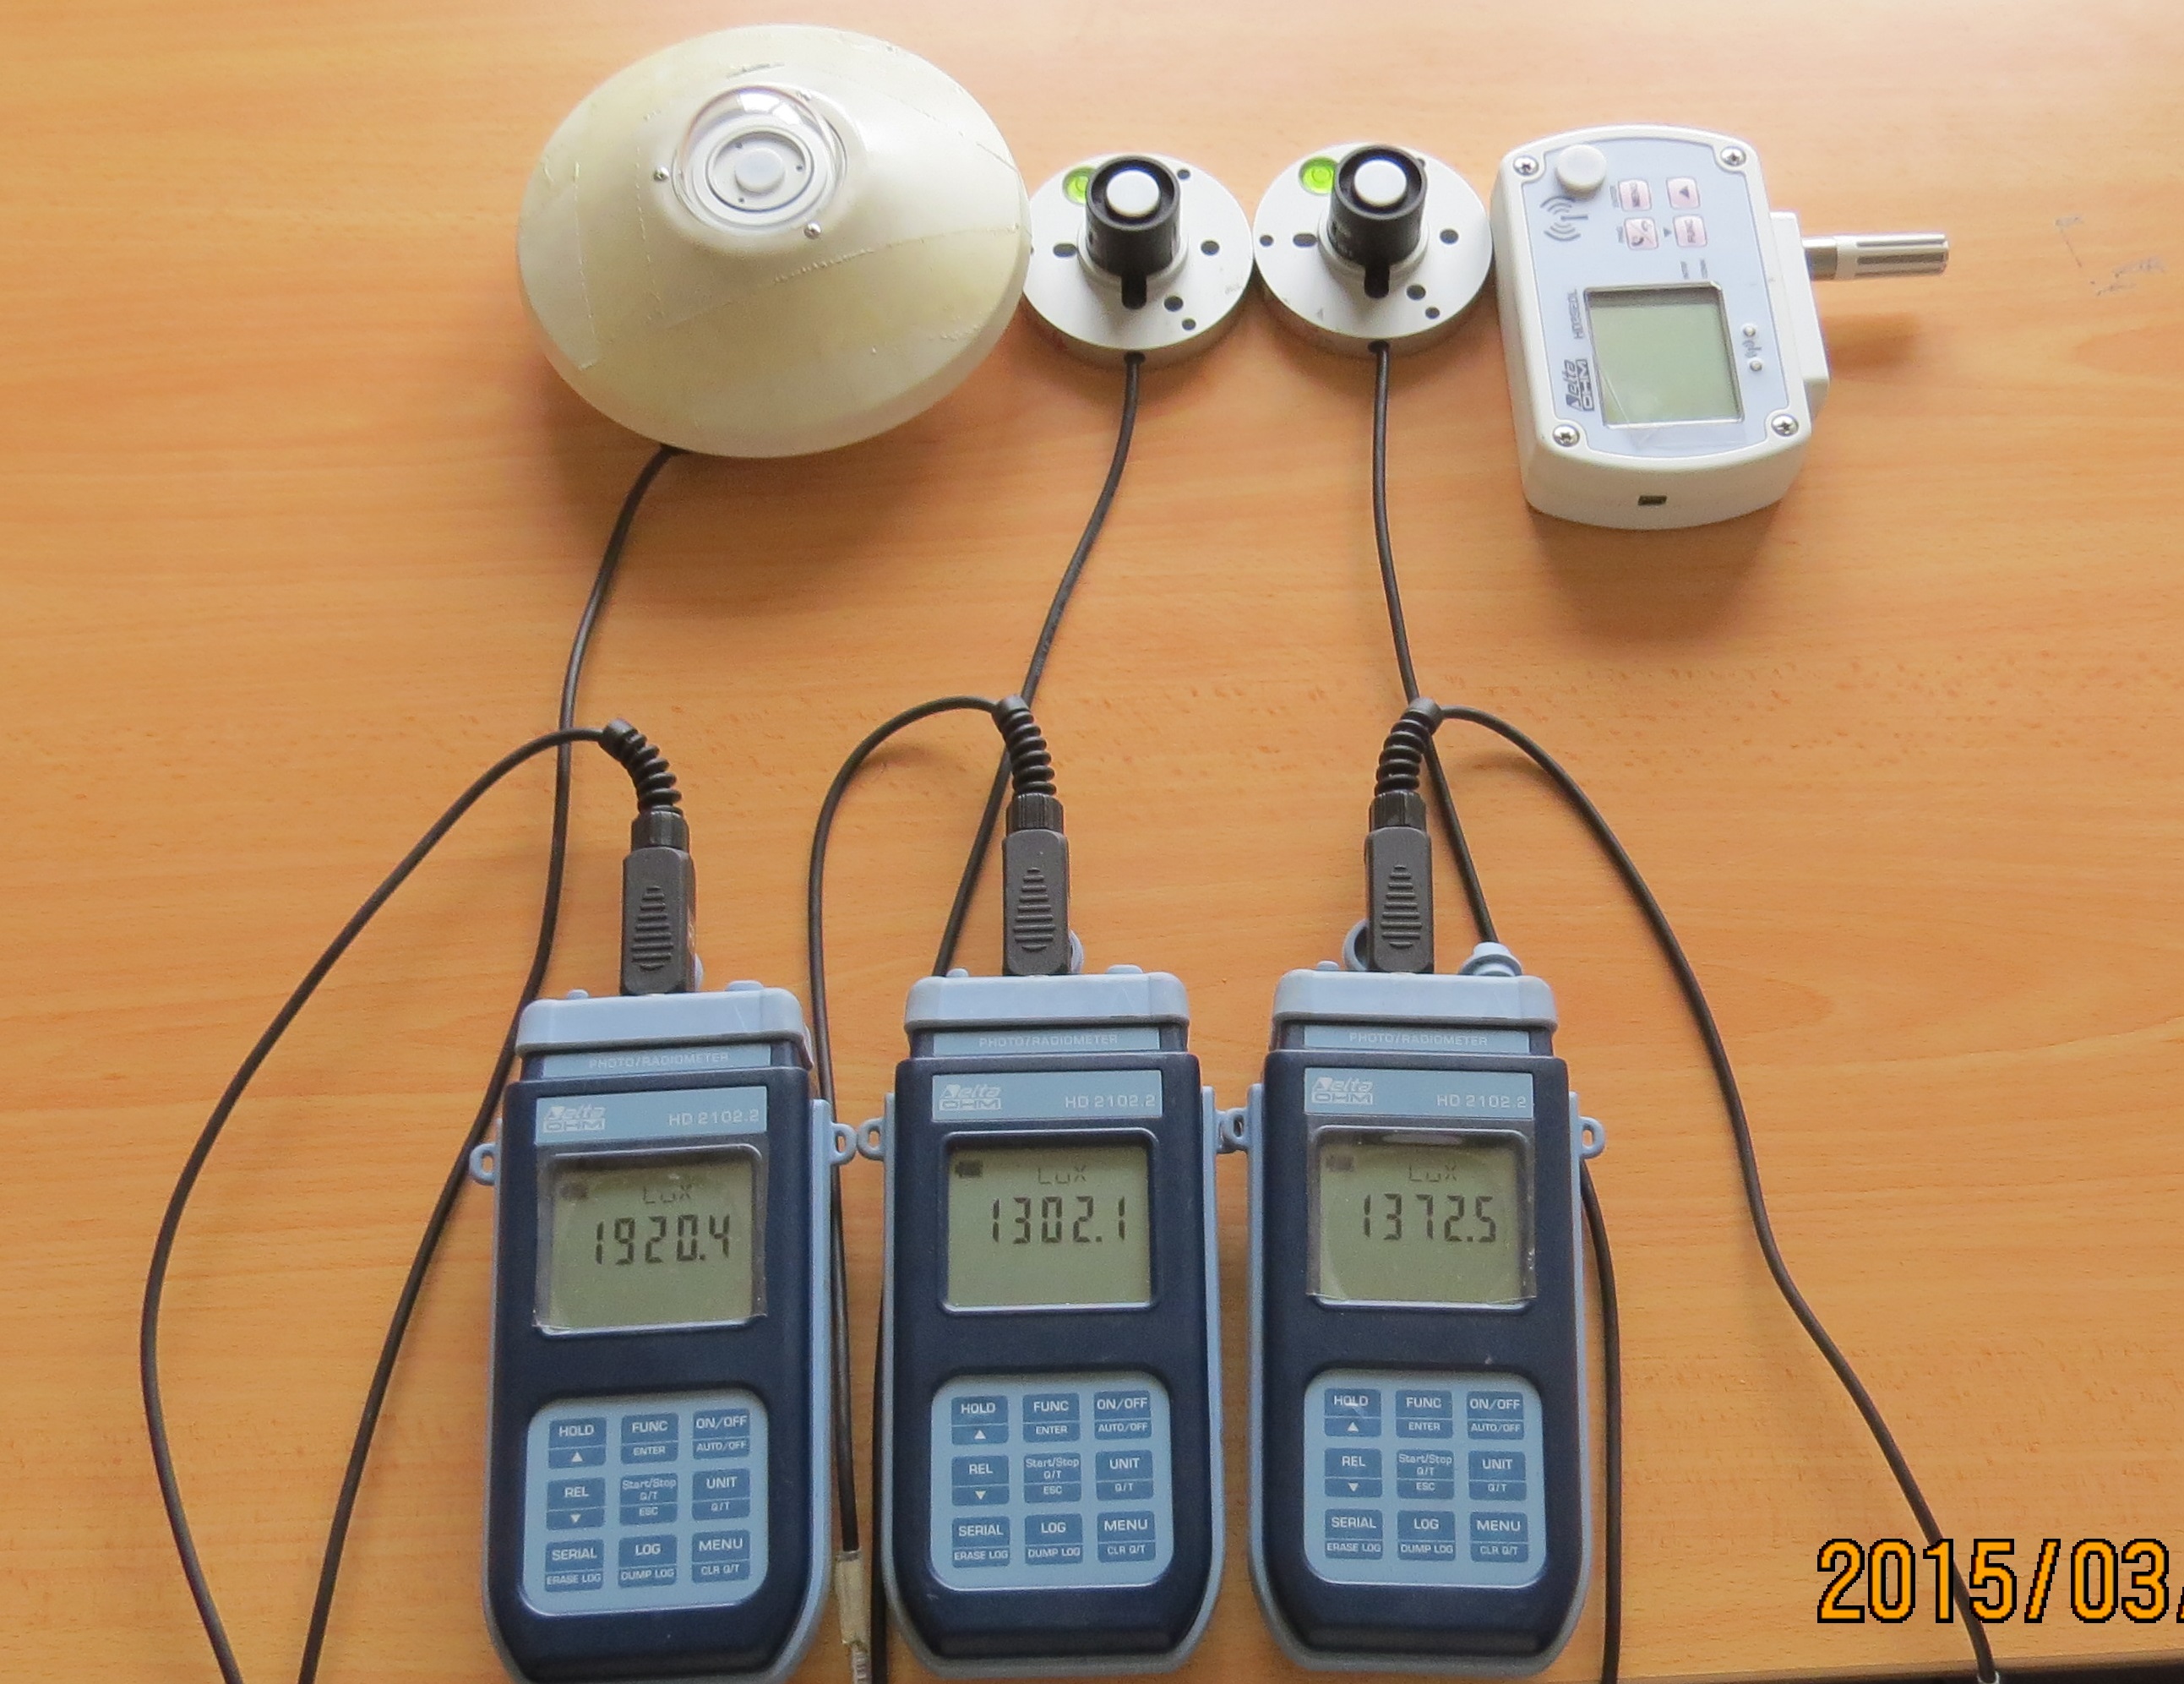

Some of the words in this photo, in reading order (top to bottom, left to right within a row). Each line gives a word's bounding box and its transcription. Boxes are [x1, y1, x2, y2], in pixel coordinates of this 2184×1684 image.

[1576, 358, 1595, 411] OHM
[979, 1034, 1118, 1048] PHOTO/RADIOMETER
[1349, 1032, 1488, 1046] PHOTO/RADIOMETER
[589, 1053, 729, 1069] PHOTO/RADIOMETER
[1065, 1095, 1089, 1108] HD
[1094, 1094, 1156, 1108] 2102.2
[1436, 1094, 1461, 1107] HD
[1465, 1094, 1527, 1109] 2102.2
[668, 1113, 694, 1125] HD
[697, 1109, 760, 1125] 2102.2
[992, 1196, 1125, 1244] 1302.1
[1363, 1193, 1496, 1243] 1372.5
[595, 1213, 730, 1266] 1920.4
[1033, 1401, 1069, 1412] FUNC
[1097, 1398, 1147, 1410] ON/OFF
[1334, 1396, 1368, 1406] HOLD
[1406, 1398, 1441, 1409] FUNC
[1470, 1399, 1520, 1409] ON/OFF
[961, 1403, 996, 1414] HOLD
[632, 1421, 668, 1432] FUNC
[696, 1415, 747, 1429] ON/OFF
[1098, 1423, 1147, 1432] AUTO/OFF
[1408, 1422, 1441, 1431] ENTER
[559, 1424, 594, 1437] HOLD
[1036, 1426, 1067, 1435] ENTER
[1471, 1424, 1520, 1432] AUTO/OFF
[634, 1446, 666, 1455] ENTER
[696, 1441, 747, 1452] AUTO/OFF
[1026, 1458, 1079, 1469] Start/Stop
[1109, 1458, 1140, 1469] UNIT
[1342, 1456, 1366, 1466] REL
[1399, 1455, 1452, 1465] Start/Stop
[1483, 1459, 1513, 1469] UNIT
[969, 1464, 993, 1474] REL
[623, 1478, 676, 1491] Start/Stop
[706, 1477, 737, 1489] UNIT
[564, 1487, 589, 1497] REL
[1043, 1486, 1062, 1495] ESC
[640, 1507, 658, 1517] ESC
[1041, 1523, 1066, 1534] LOG
[1104, 1520, 1148, 1531] MENU
[1332, 1518, 1376, 1529] SERIAL
[1414, 1519, 1439, 1529] LOG
[1477, 1520, 1521, 1531] MENU
[958, 1525, 1004, 1536] SERIAL
[635, 1544, 661, 1556] LOG
[699, 1539, 743, 1551] MENU
[1108, 1546, 1125, 1555] CLR
[1327, 1543, 1359, 1551] ERASE
[1362, 1544, 1381, 1552] LOG
[1401, 1544, 1431, 1553] DUMP
[1434, 1545, 1453, 1554] LOG
[1480, 1546, 1499, 1555] CLR
[552, 1548, 597, 1561] SERIAL
[955, 1551, 986, 1560] ERASE
[989, 1550, 1008, 1559] LOG
[1028, 1549, 1059, 1558] DUMP
[1062, 1547, 1081, 1556] LOG
[621, 1571, 652, 1580] DUMP
[655, 1568, 674, 1578] LOG
[701, 1567, 720, 1575] CLR
[547, 1576, 580, 1585] ERASE
[582, 1573, 601, 1583] LOG
